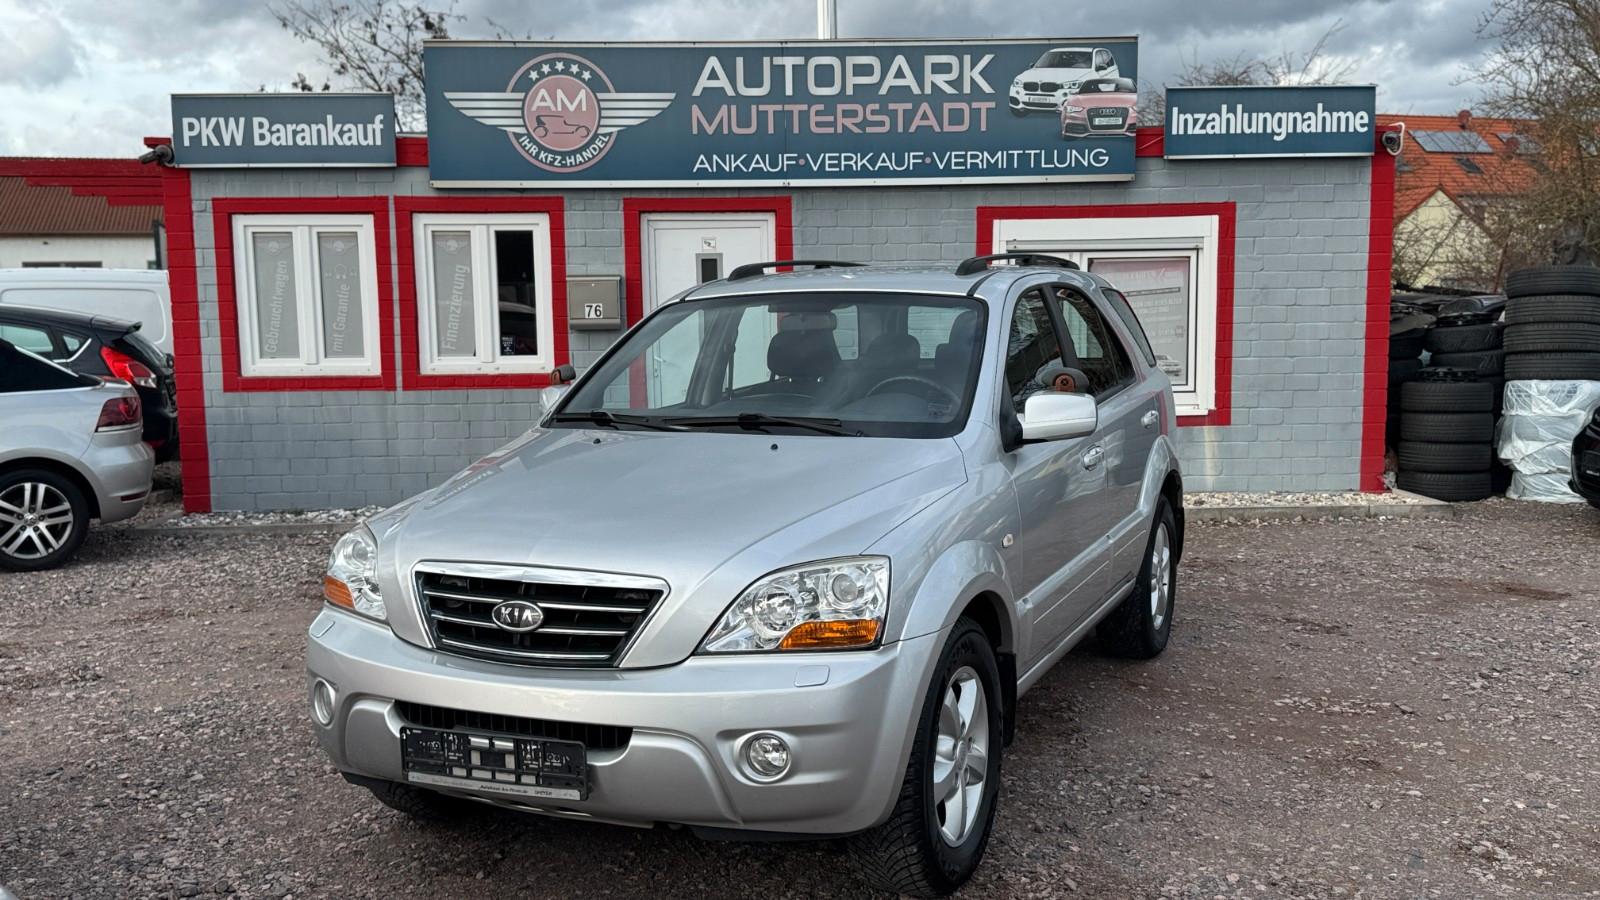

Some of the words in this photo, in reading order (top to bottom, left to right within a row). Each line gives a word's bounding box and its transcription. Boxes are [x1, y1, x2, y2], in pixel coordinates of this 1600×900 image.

[691, 54, 996, 96] AUTOPARK
[530, 88, 587, 112] AM
[182, 117, 245, 147] PKW
[252, 114, 384, 147] Barankauf
[691, 101, 996, 135] MUTTERSTADT
[1171, 103, 1369, 142] Inzahlungnahme
[518, 135, 539, 157] IHR
[538, 135, 610, 167] KFZ-HANDEL
[932, 148, 1109, 170] VERMITTLUNG
[264, 260, 290, 353] Gebrauchtwagen
[332, 283, 351, 331] Garantie
[441, 263, 471, 351] Finanzierung
[585, 304, 602, 318] 76
[332, 333, 345, 352] mit
[499, 606, 534, 625] KIA
